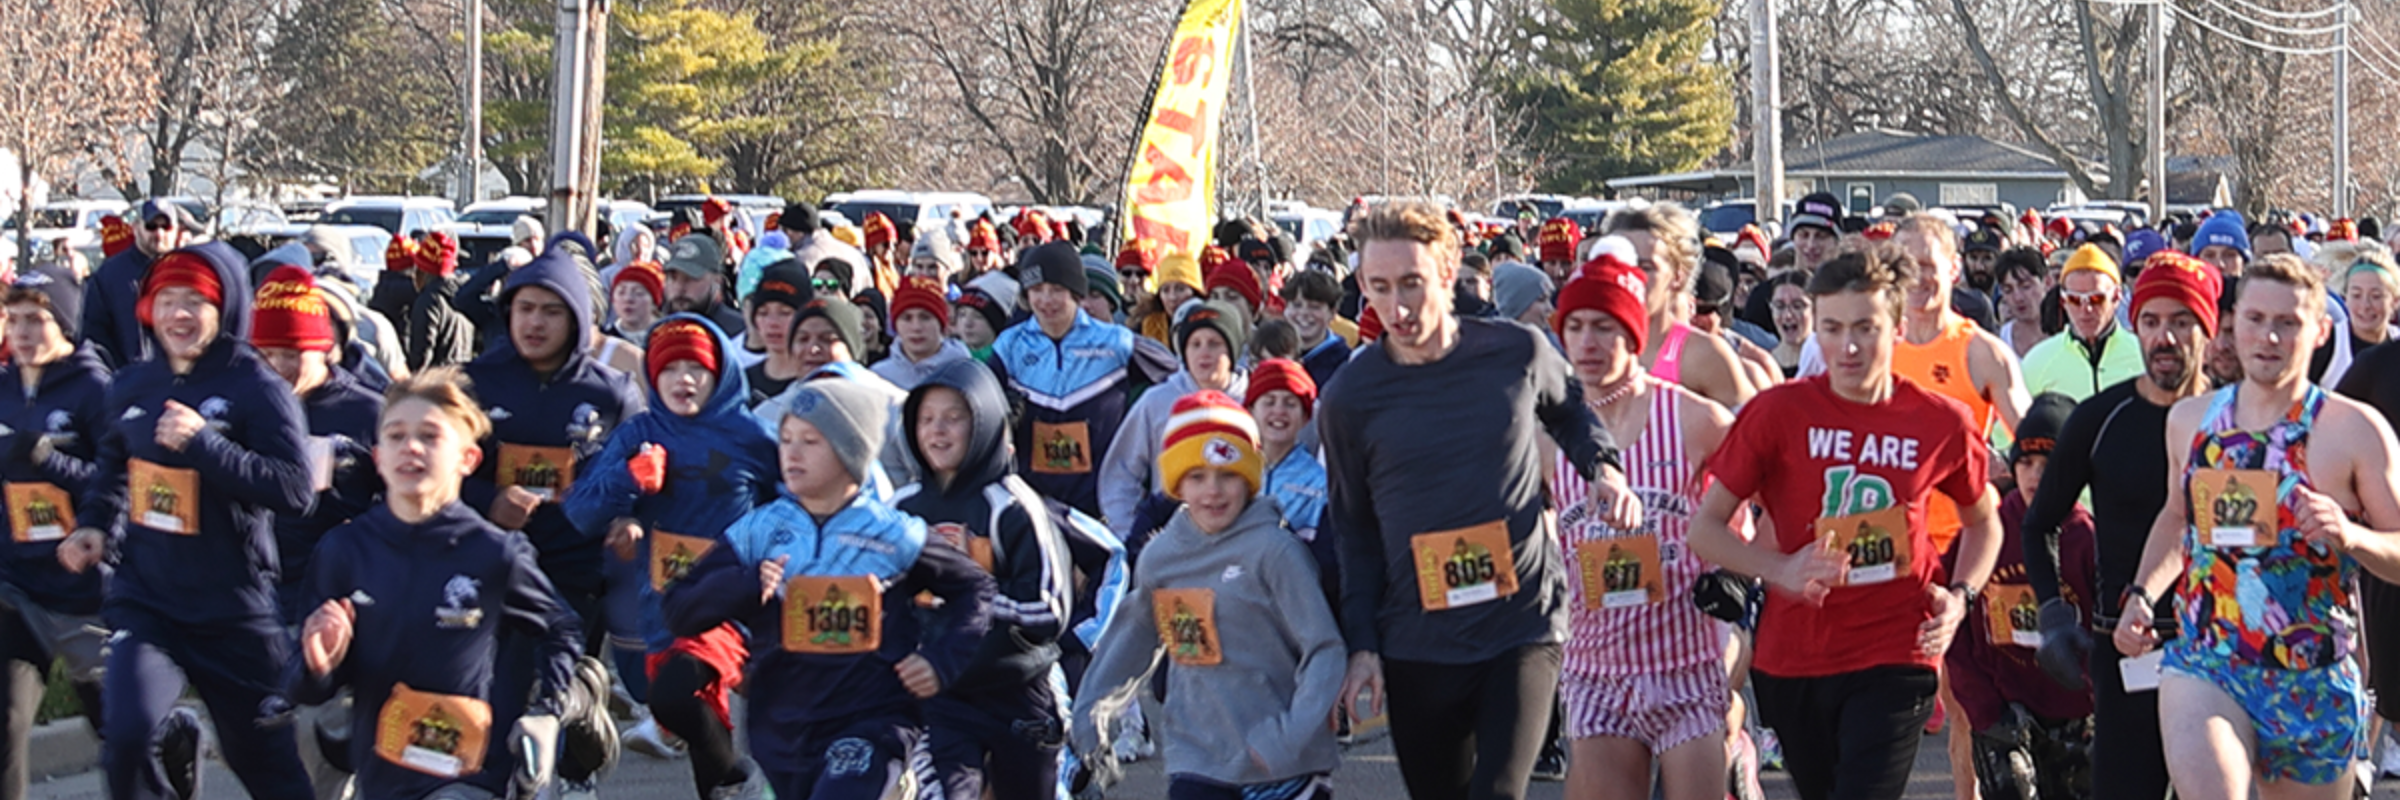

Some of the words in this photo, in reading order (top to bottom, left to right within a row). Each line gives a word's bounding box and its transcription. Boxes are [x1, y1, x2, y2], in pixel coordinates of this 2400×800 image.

[1131, 36, 1215, 267] STAR
[1808, 427, 1852, 460] WE
[1858, 433, 1919, 469] ARE
[2212, 498, 2257, 526] 922
[1444, 552, 1495, 587] 805
[1847, 537, 1895, 567] 260
[1420, 545, 1439, 601] turkey
[806, 605, 869, 634] 1309
